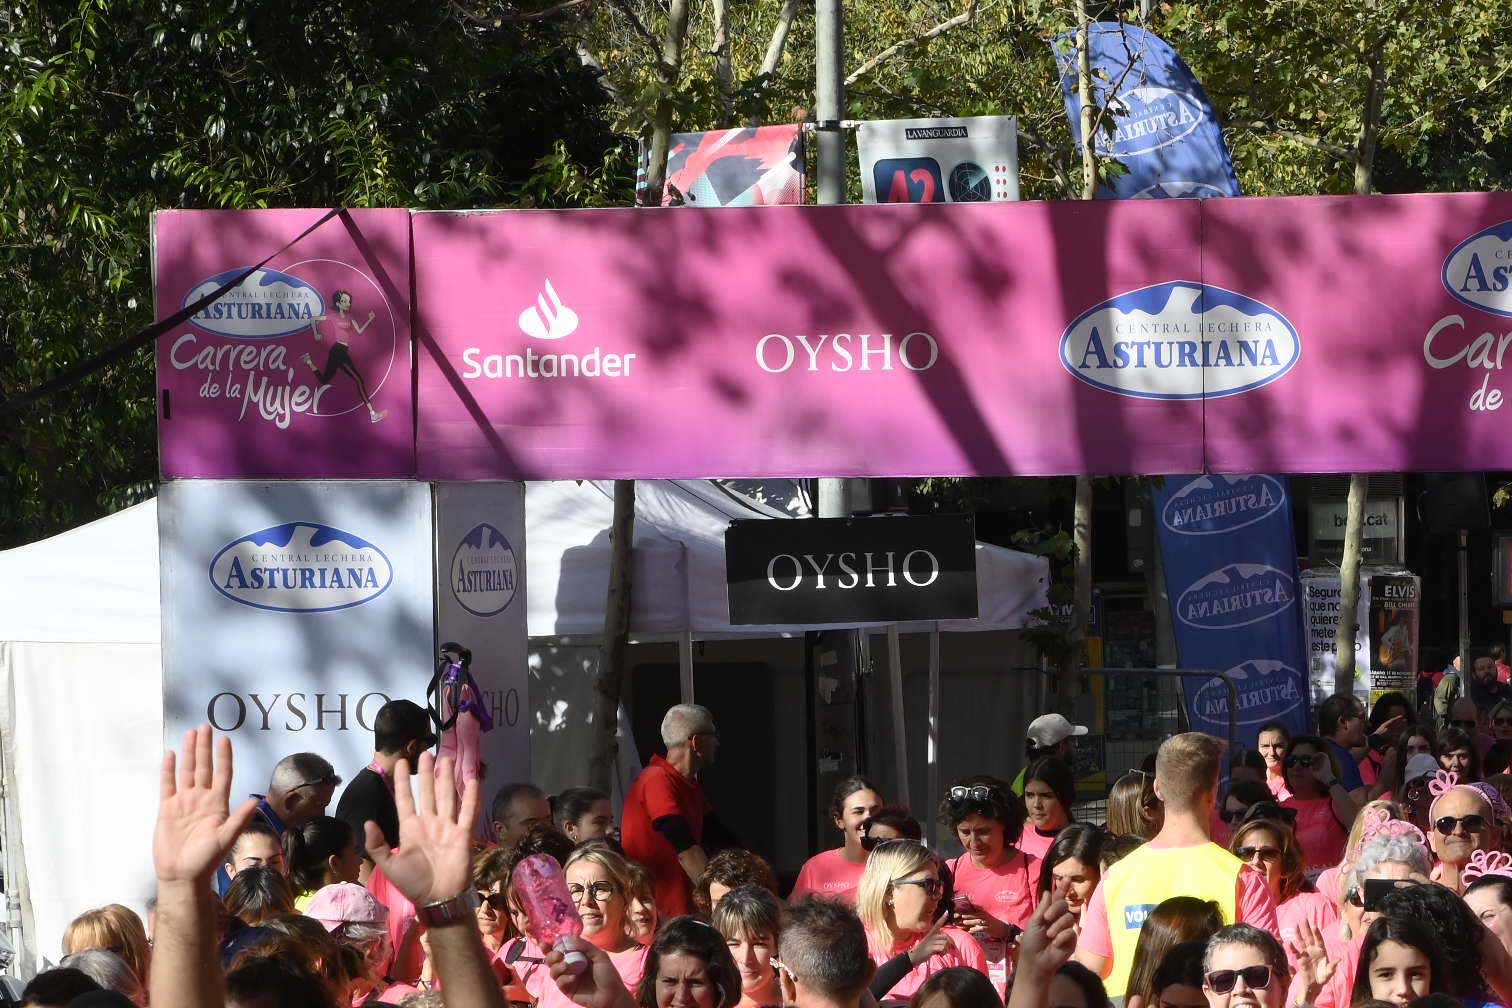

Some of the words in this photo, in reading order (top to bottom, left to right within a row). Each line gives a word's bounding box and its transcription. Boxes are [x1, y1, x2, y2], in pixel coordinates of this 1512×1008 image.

[1115, 322, 1191, 334] CENTRAL
[1198, 321, 1273, 334] LECHERA
[170, 333, 288, 371] Carrera
[462, 346, 637, 379] Santander
[755, 333, 938, 373] OYSHO
[1078, 326, 1282, 369] ASTURIANA
[199, 370, 221, 398] de
[226, 370, 241, 398] la
[238, 367, 333, 430] Mujer
[1469, 373, 1504, 411] de
[224, 556, 379, 589] ASTURIANA
[250, 553, 311, 563] CENTRAL
[315, 552, 374, 563] LECHERA
[456, 557, 514, 593] ASTURIANA
[767, 549, 940, 592] OYSHO
[1384, 585, 1415, 598] ELVIS
[206, 692, 391, 732] OYSHO
